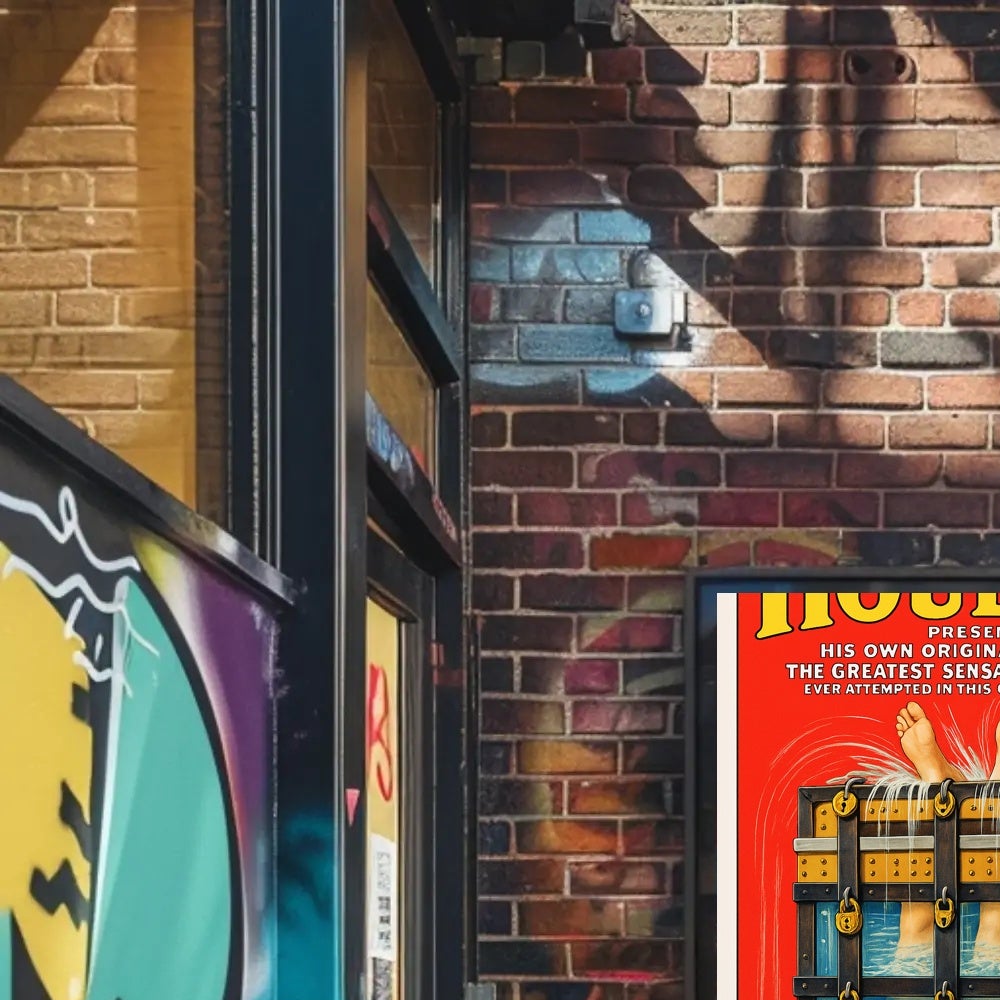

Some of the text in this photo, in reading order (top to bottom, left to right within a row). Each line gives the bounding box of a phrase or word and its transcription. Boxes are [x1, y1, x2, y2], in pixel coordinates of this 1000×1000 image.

[820, 643, 855, 659] HIS
[863, 643, 914, 659] OWN
[785, 662, 824, 680] THE
[831, 662, 935, 680] GREATEST
[804, 682, 842, 696] EVER
[845, 682, 932, 696] ATTEMPTED
[936, 682, 953, 696] IN
[957, 682, 991, 696] THIS
